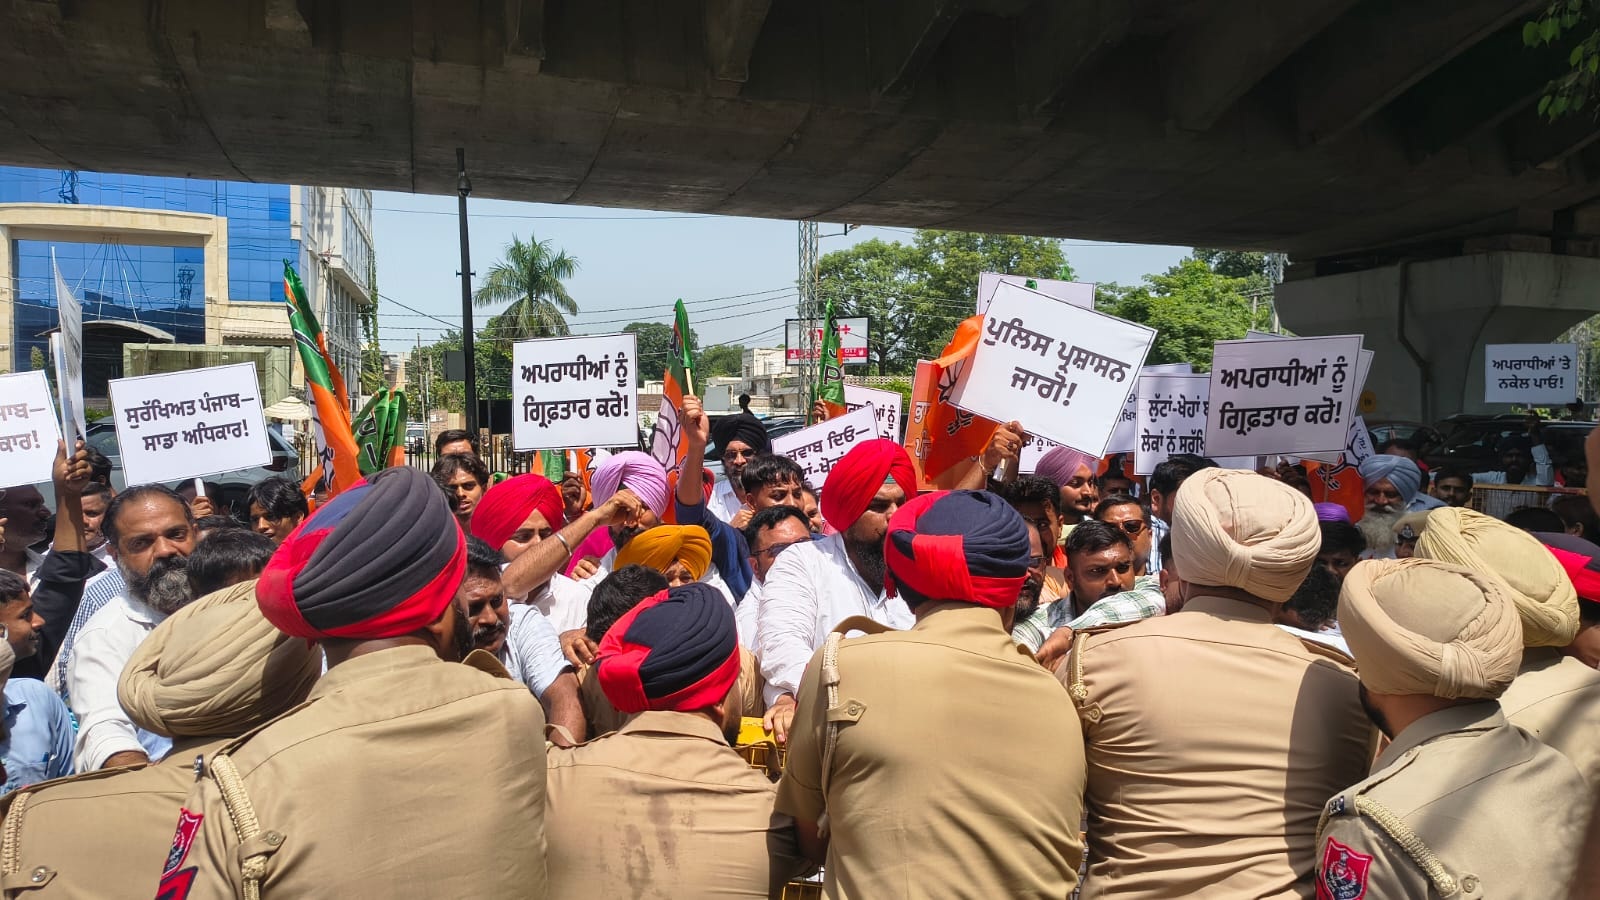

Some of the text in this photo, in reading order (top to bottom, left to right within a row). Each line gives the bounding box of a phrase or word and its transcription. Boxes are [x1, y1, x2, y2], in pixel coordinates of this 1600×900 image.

[984, 317, 1132, 383] ਪੁਲਿਸ ਪ੍ਰਸ਼ਾਸਨ
[1492, 356, 1555, 370] ਅਪਰਾਧੀਆਂ
[521, 351, 628, 387] ਅਪਰਾਧੀਆਂ ਨੂੰ
[1010, 366, 1078, 406] ਜਾਗੋ!
[1220, 355, 1348, 393] ਅਪਰਾਧੀਆਂ ਨੂੰ
[1498, 374, 1564, 389] ਨਕੇਲ ਪਾਓ!
[124, 396, 196, 429] ਸੁਰੱਖਿਅਤ
[523, 390, 629, 428] ਗ੍ਰਿਫ਼ਤਾਰ ਕਰੋ!
[1219, 401, 1300, 436] ਗ੍ਰਿਫ਼ਤਾਰ
[1304, 396, 1342, 424] ਕਰੋ!
[0, 430, 40, 452] ਕਾਰ!
[143, 418, 249, 451] ਸਾਡਾ ਅਧਿਕਾਰ!
[1141, 428, 1164, 452] ਲੋਕਾਂ
